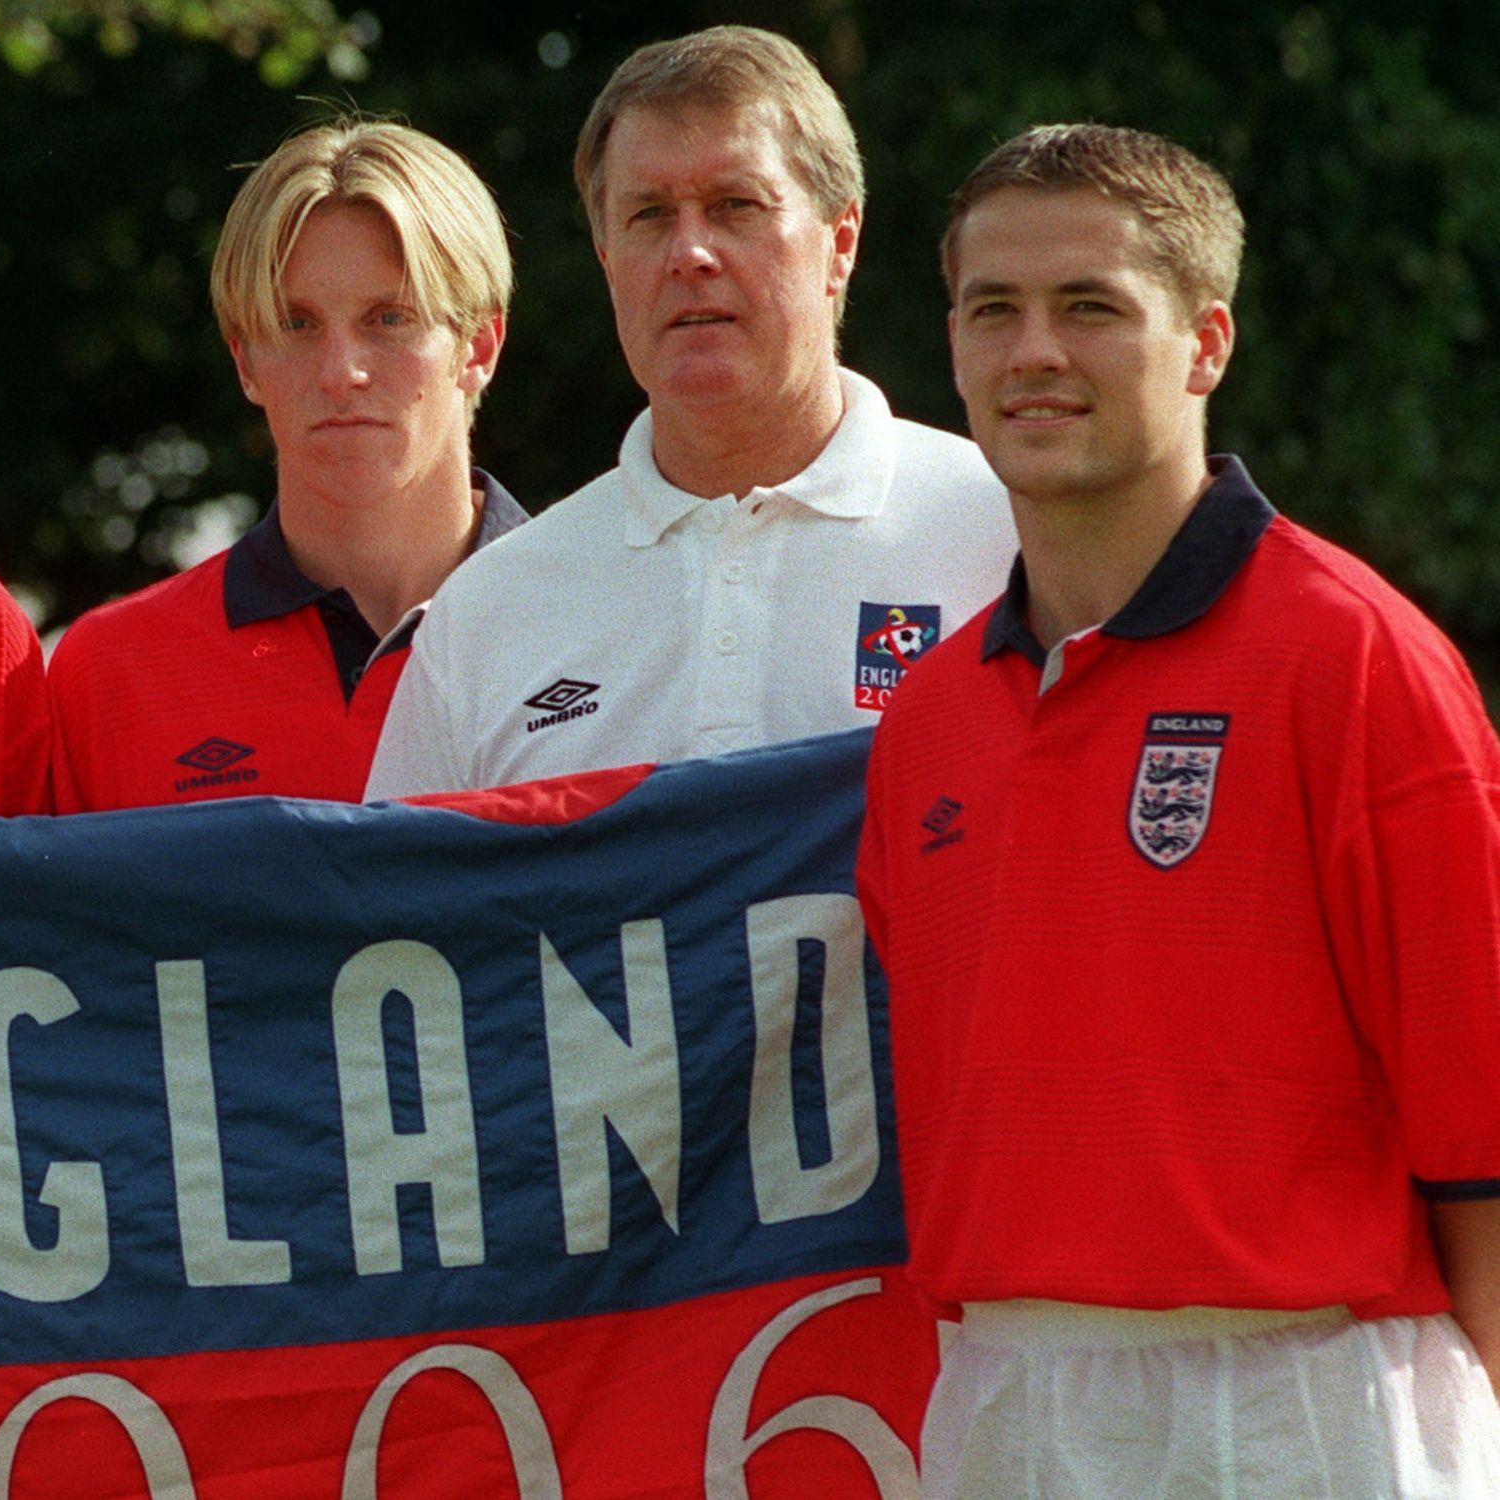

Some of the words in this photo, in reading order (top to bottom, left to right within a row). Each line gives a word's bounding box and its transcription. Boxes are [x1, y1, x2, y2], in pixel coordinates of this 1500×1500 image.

[860, 666, 908, 688] ENGL
[858, 687, 893, 707] 20
[527, 701, 599, 733] UMBRO
